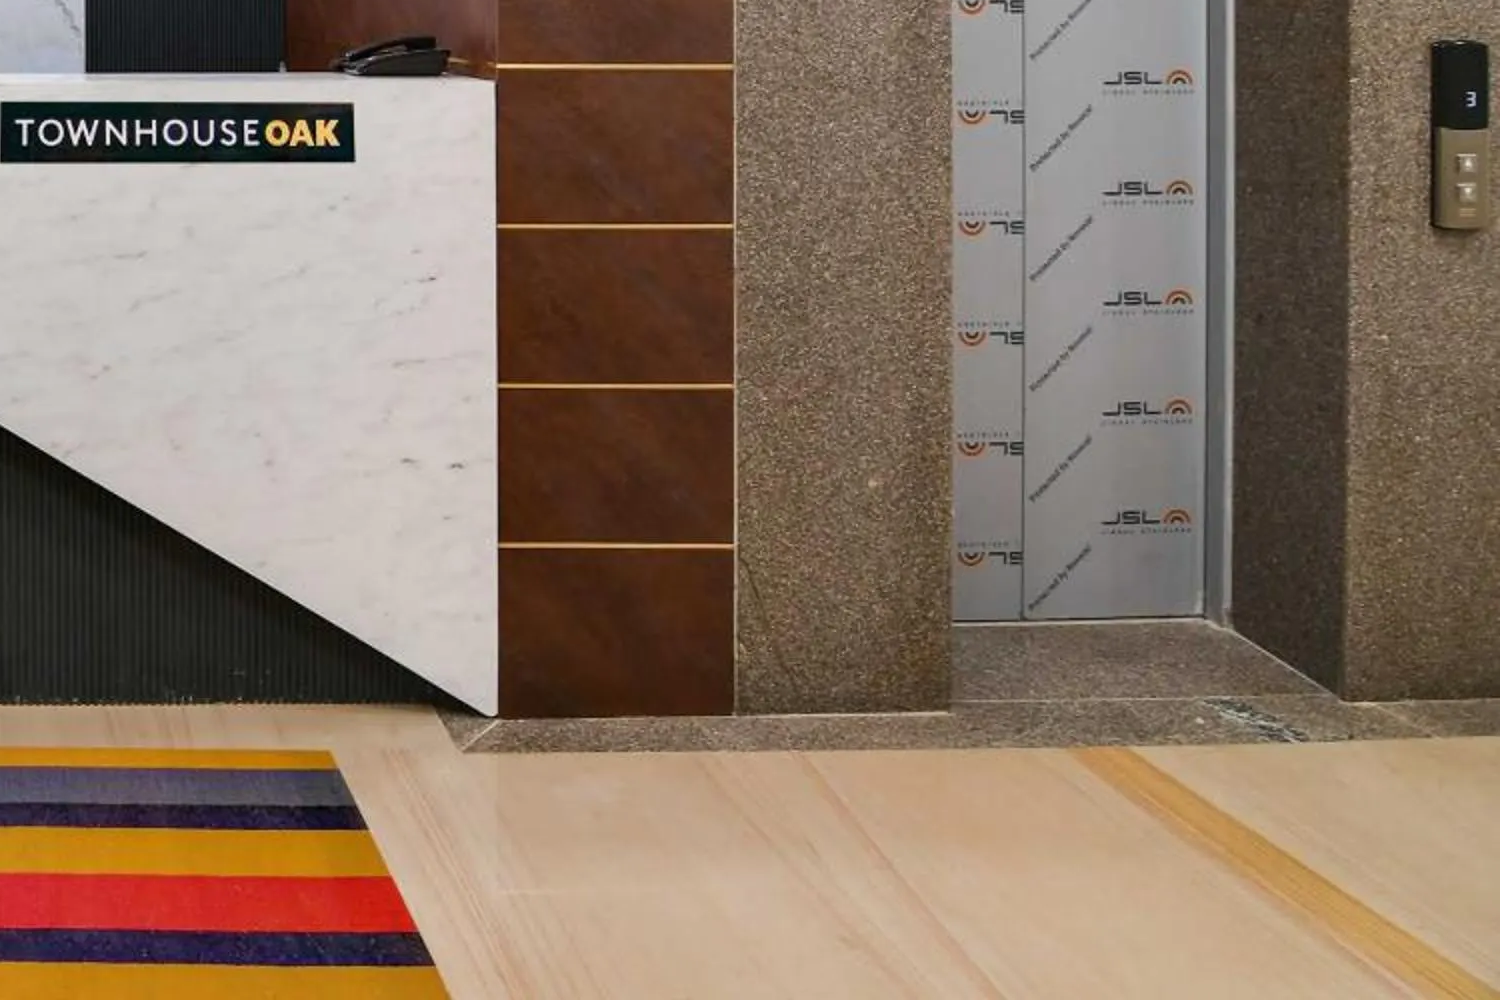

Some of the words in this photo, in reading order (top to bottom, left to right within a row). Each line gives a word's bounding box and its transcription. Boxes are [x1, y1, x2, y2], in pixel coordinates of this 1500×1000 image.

[1103, 71, 1163, 85] JSL
[1465, 91, 1477, 107] 3
[14, 119, 260, 147] TOWNHOUSE
[264, 119, 341, 147] OAK
[1103, 181, 1163, 196] JSL
[1103, 291, 1163, 306] JSL
[1102, 401, 1162, 416] JSL
[1102, 511, 1161, 526] JSL
